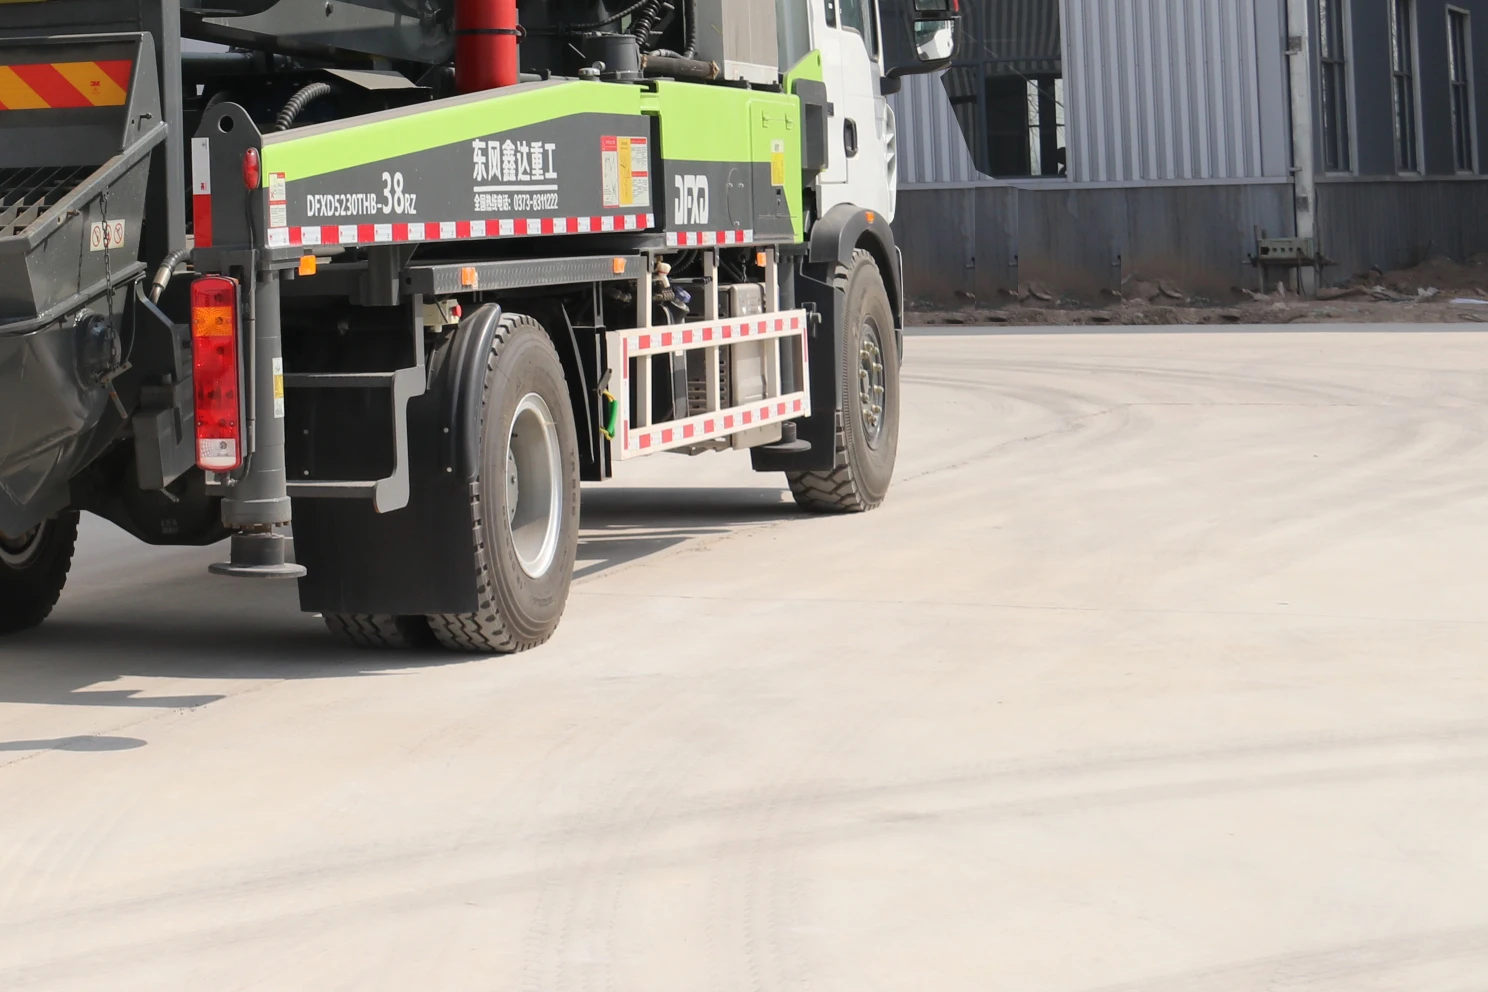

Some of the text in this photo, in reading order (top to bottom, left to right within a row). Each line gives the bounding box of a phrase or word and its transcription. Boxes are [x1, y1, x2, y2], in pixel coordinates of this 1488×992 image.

[472, 138, 557, 182] 东风鑫达重工
[513, 193, 558, 211] 0373-8311222
